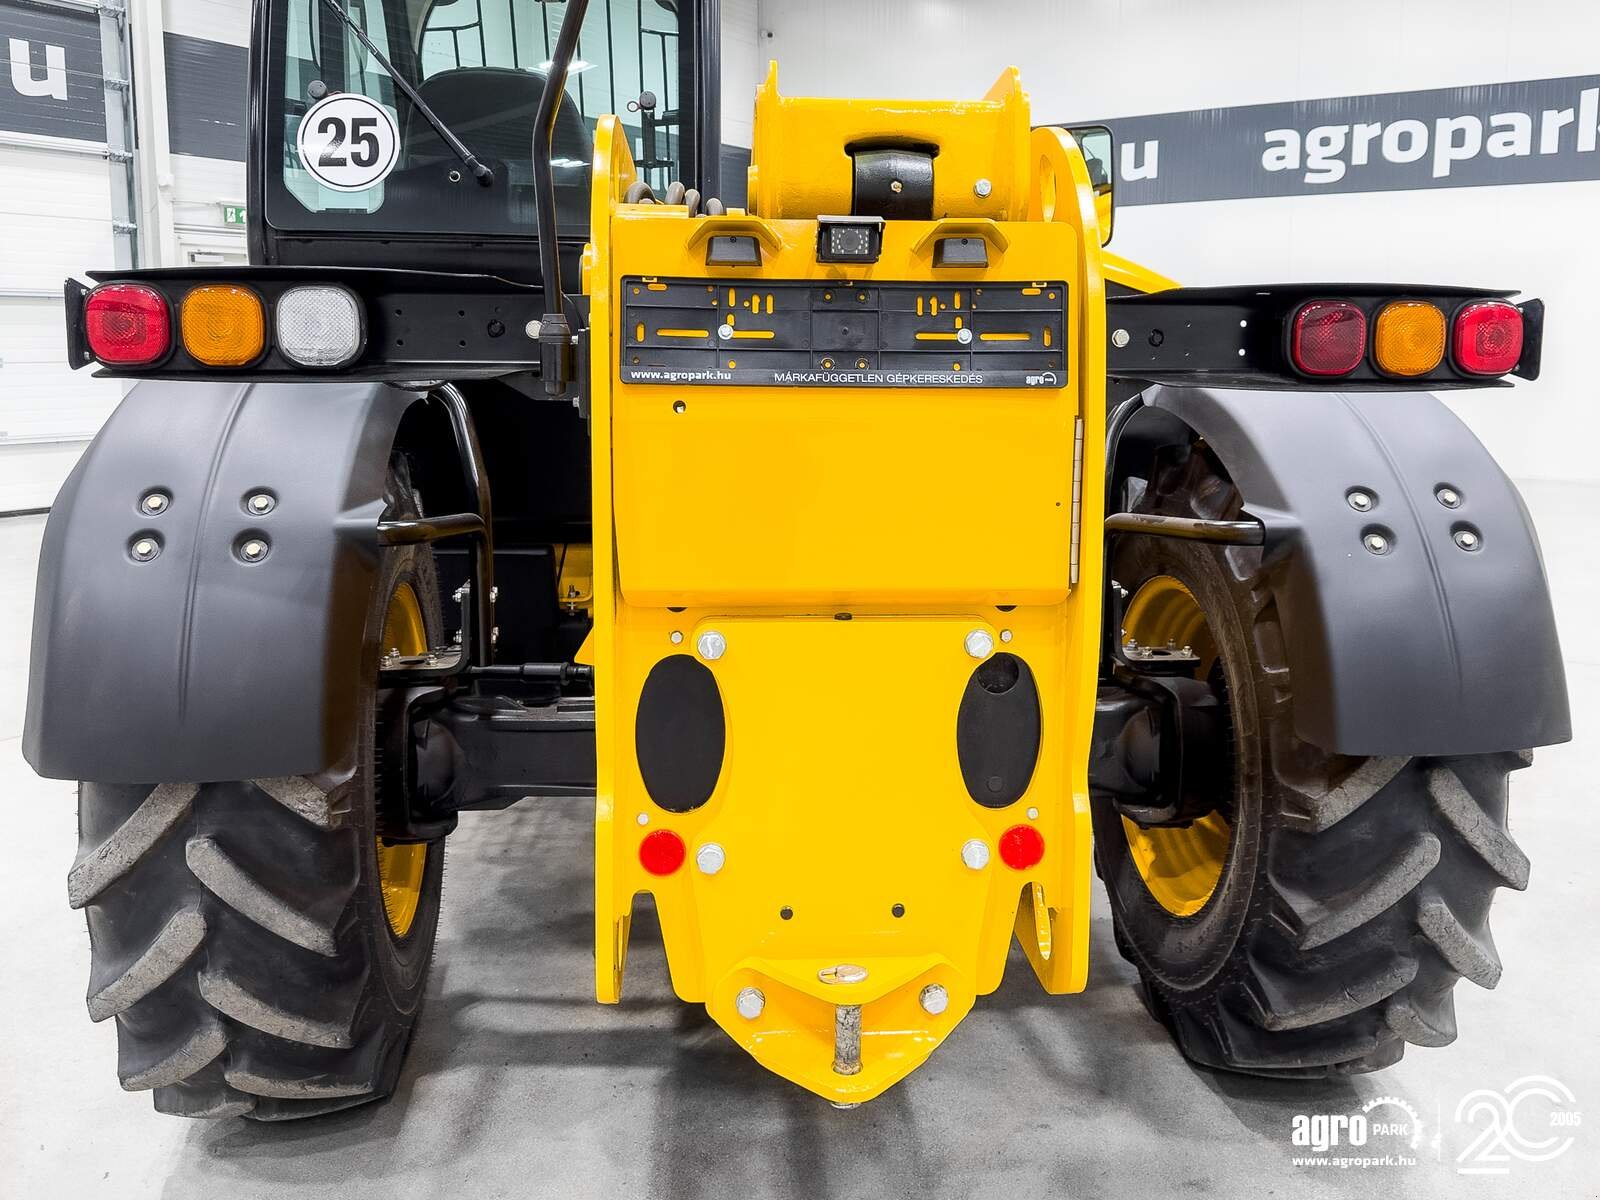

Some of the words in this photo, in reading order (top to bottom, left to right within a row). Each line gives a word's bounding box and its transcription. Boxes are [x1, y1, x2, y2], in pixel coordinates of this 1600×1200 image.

[317, 116, 380, 168] 25
[630, 370, 732, 382] www.agropark.hu
[774, 371, 884, 384] MÁRKAFÜGGETLEN
[886, 372, 983, 385] GÉPKERESKEDÉS
